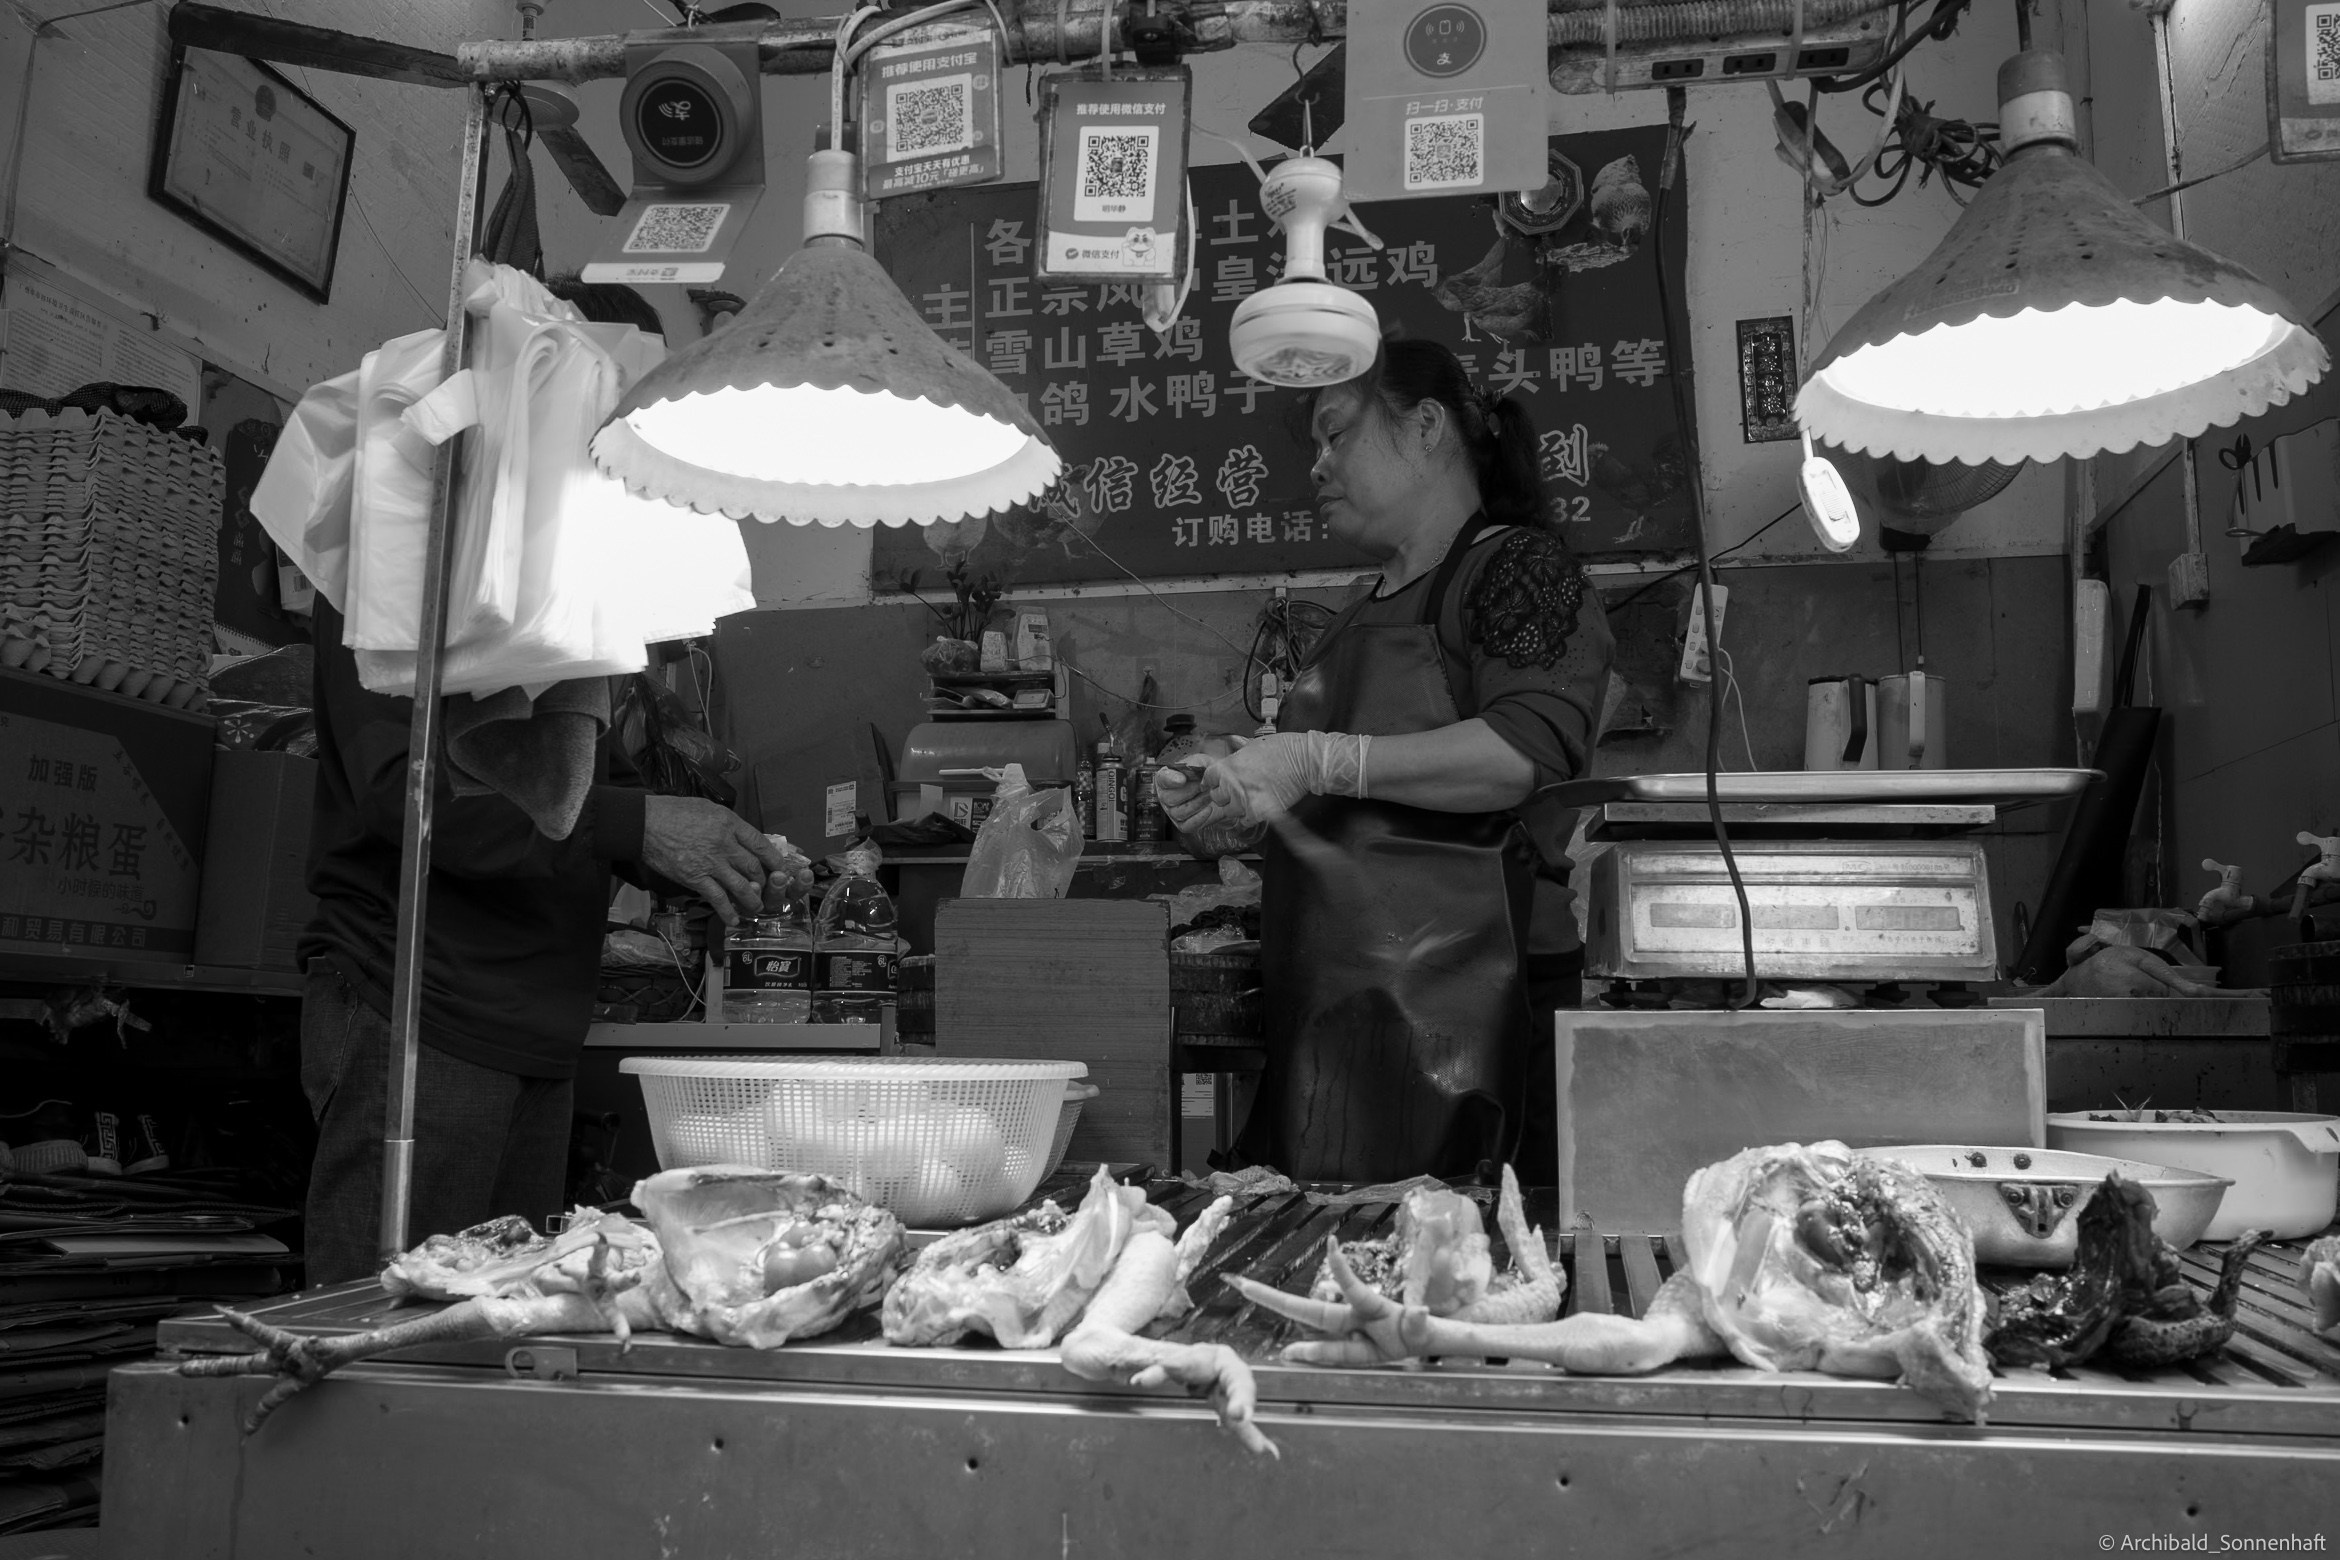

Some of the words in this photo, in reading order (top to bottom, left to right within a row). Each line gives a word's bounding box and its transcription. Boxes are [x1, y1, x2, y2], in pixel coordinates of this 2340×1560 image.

[882, 52, 977, 78] 推荐使用支付宝
[1076, 103, 1166, 116] 推荐使用微信支付
[1406, 96, 1483, 115] 扫一扫·支付
[230, 106, 290, 164] 营业执照
[895, 155, 970, 177] 支付宝天天有优惠
[1082, 249, 1119, 260] 微信支付
[985, 316, 1204, 375] 雪山草鸡
[28, 754, 98, 793] 加强版
[0, 807, 147, 881] 杂粮蛋
